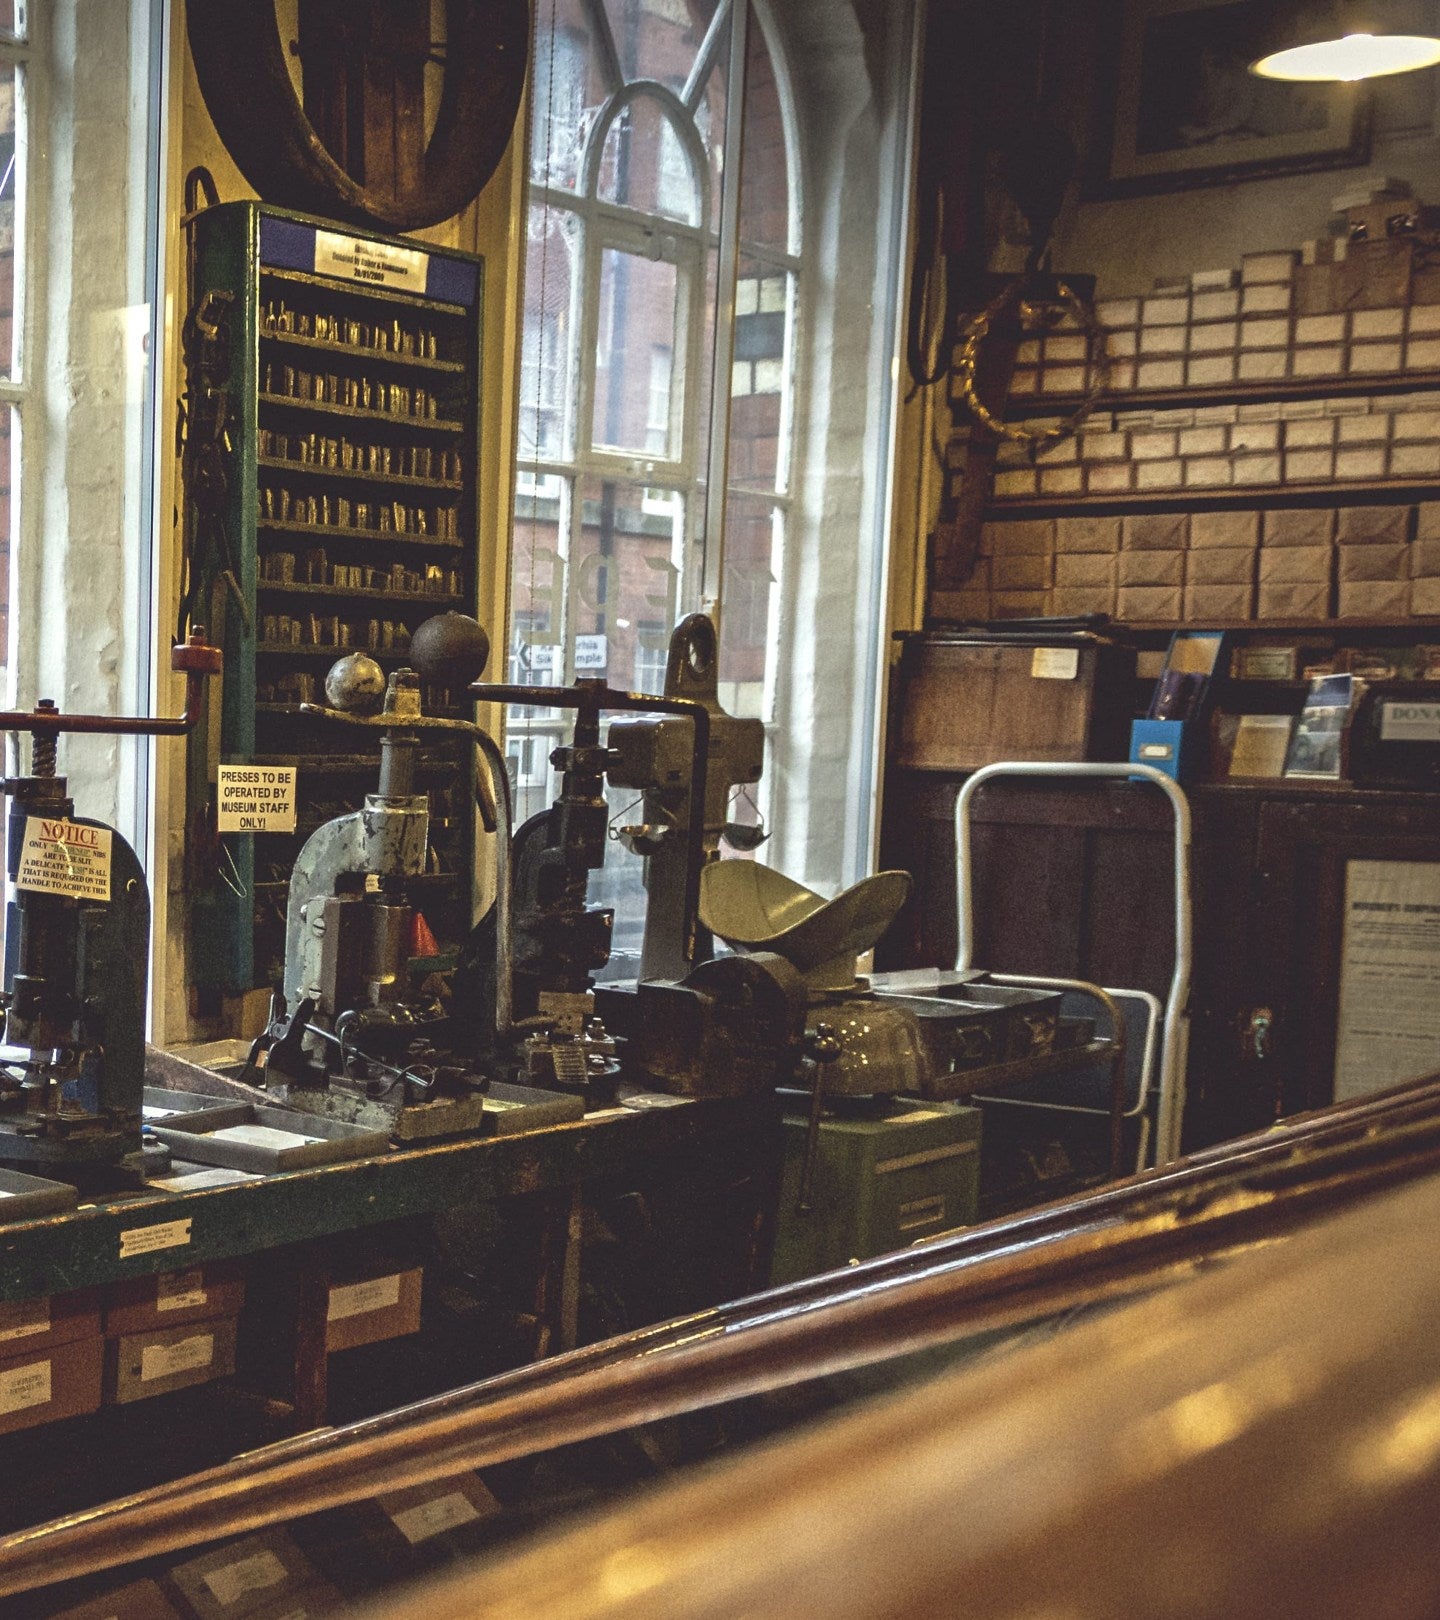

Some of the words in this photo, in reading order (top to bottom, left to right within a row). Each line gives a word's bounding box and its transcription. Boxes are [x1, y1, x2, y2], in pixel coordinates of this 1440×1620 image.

[221, 772, 260, 783] PRESSES
[262, 773, 275, 783] TO
[278, 773, 291, 783] BE
[224, 787, 271, 798] OPERATED
[273, 788, 286, 798] BY
[221, 802, 257, 813] MUSEUM
[259, 803, 289, 813] STAFF
[240, 817, 266, 829] ONLY!
[40, 821, 99, 846] NOTICE
[29, 841, 48, 850] ONLY
[43, 852, 57, 860] ARE
[78, 857, 92, 866] SLIT
[25, 858, 30, 866] A
[31, 859, 65, 871] DELICATE
[96, 869, 107, 877] ALL
[23, 868, 42, 877] THAT
[43, 869, 50, 878] IS
[95, 878, 106, 886] THE
[22, 877, 50, 888] HANDLE
[62, 883, 91, 893] ACHIEVE
[92, 887, 107, 895] THIS
